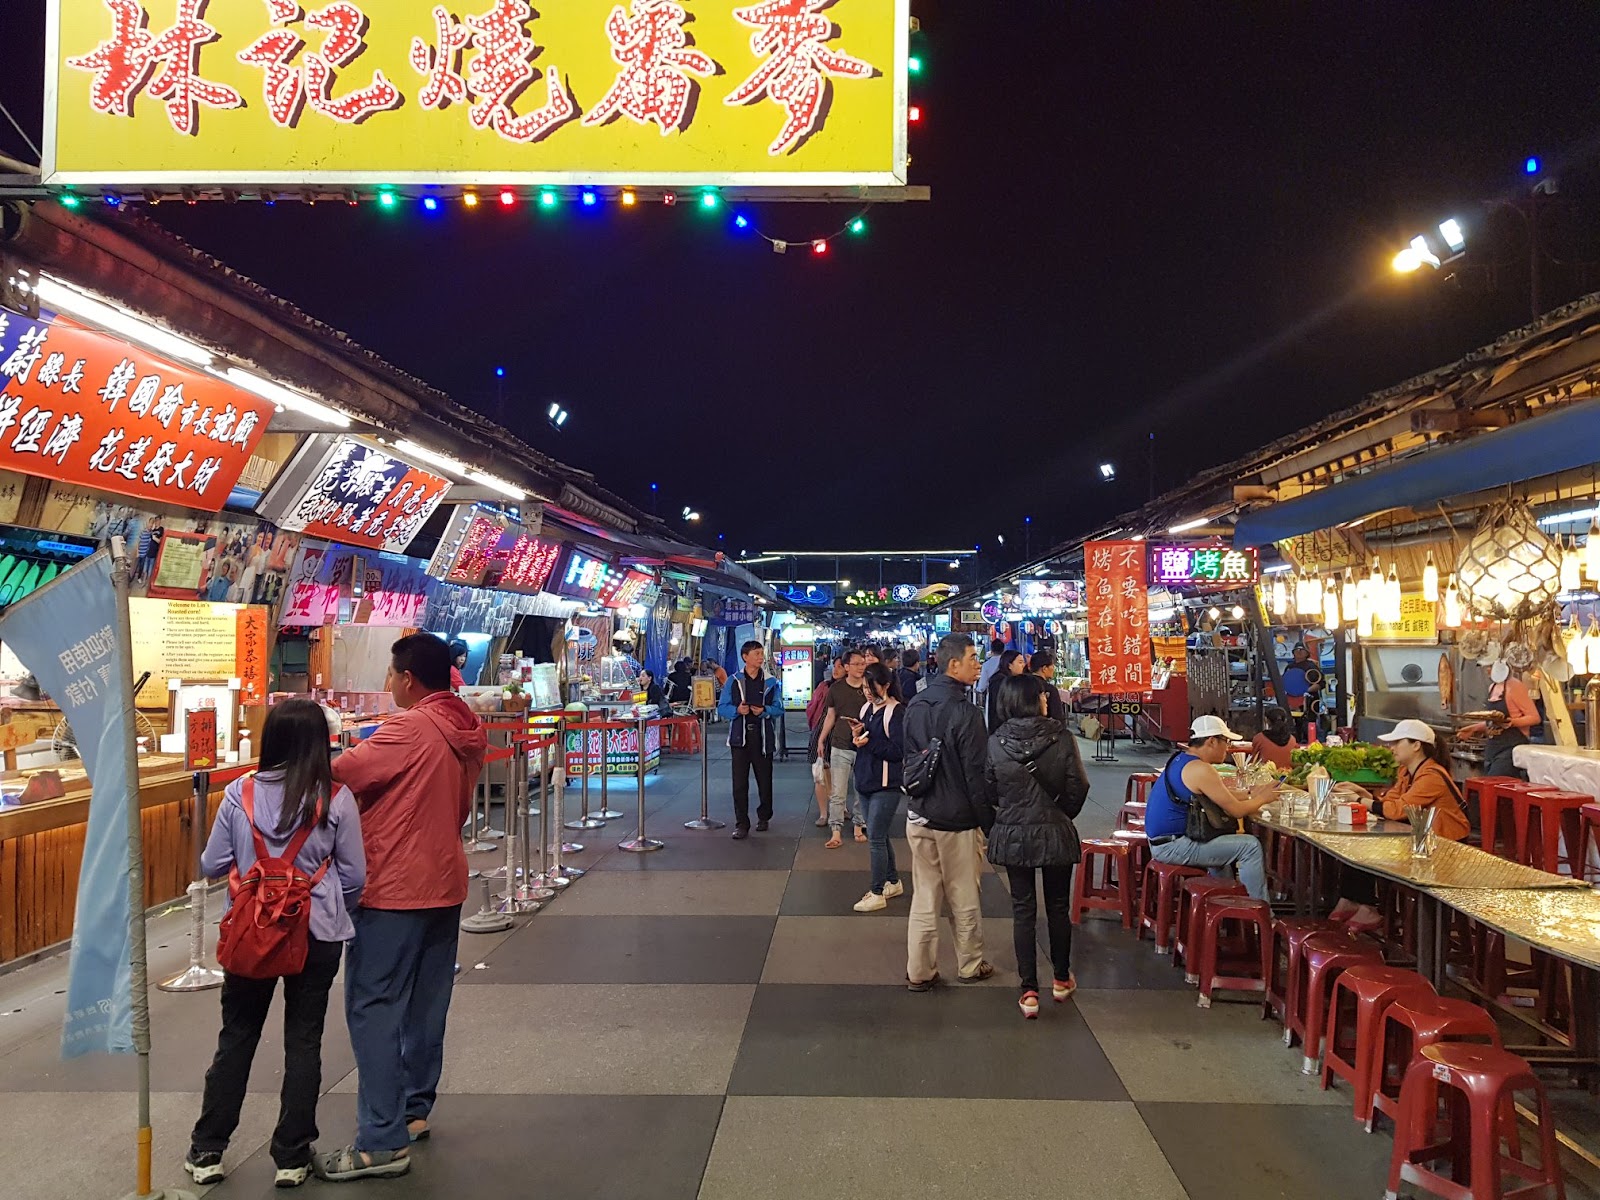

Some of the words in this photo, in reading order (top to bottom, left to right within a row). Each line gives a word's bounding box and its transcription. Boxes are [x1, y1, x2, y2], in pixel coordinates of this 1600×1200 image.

[98, 358, 260, 451] 韓國瑜市長就職
[89, 428, 223, 496] 花蓮發大財
[1160, 550, 1250, 579] 鹽烤魚
[1091, 549, 1118, 685] 烤魚在這裡
[1119, 549, 1144, 685] 不要吃錯間
[588, 729, 639, 754] 花大西瓜
[1110, 702, 1141, 714] 350
